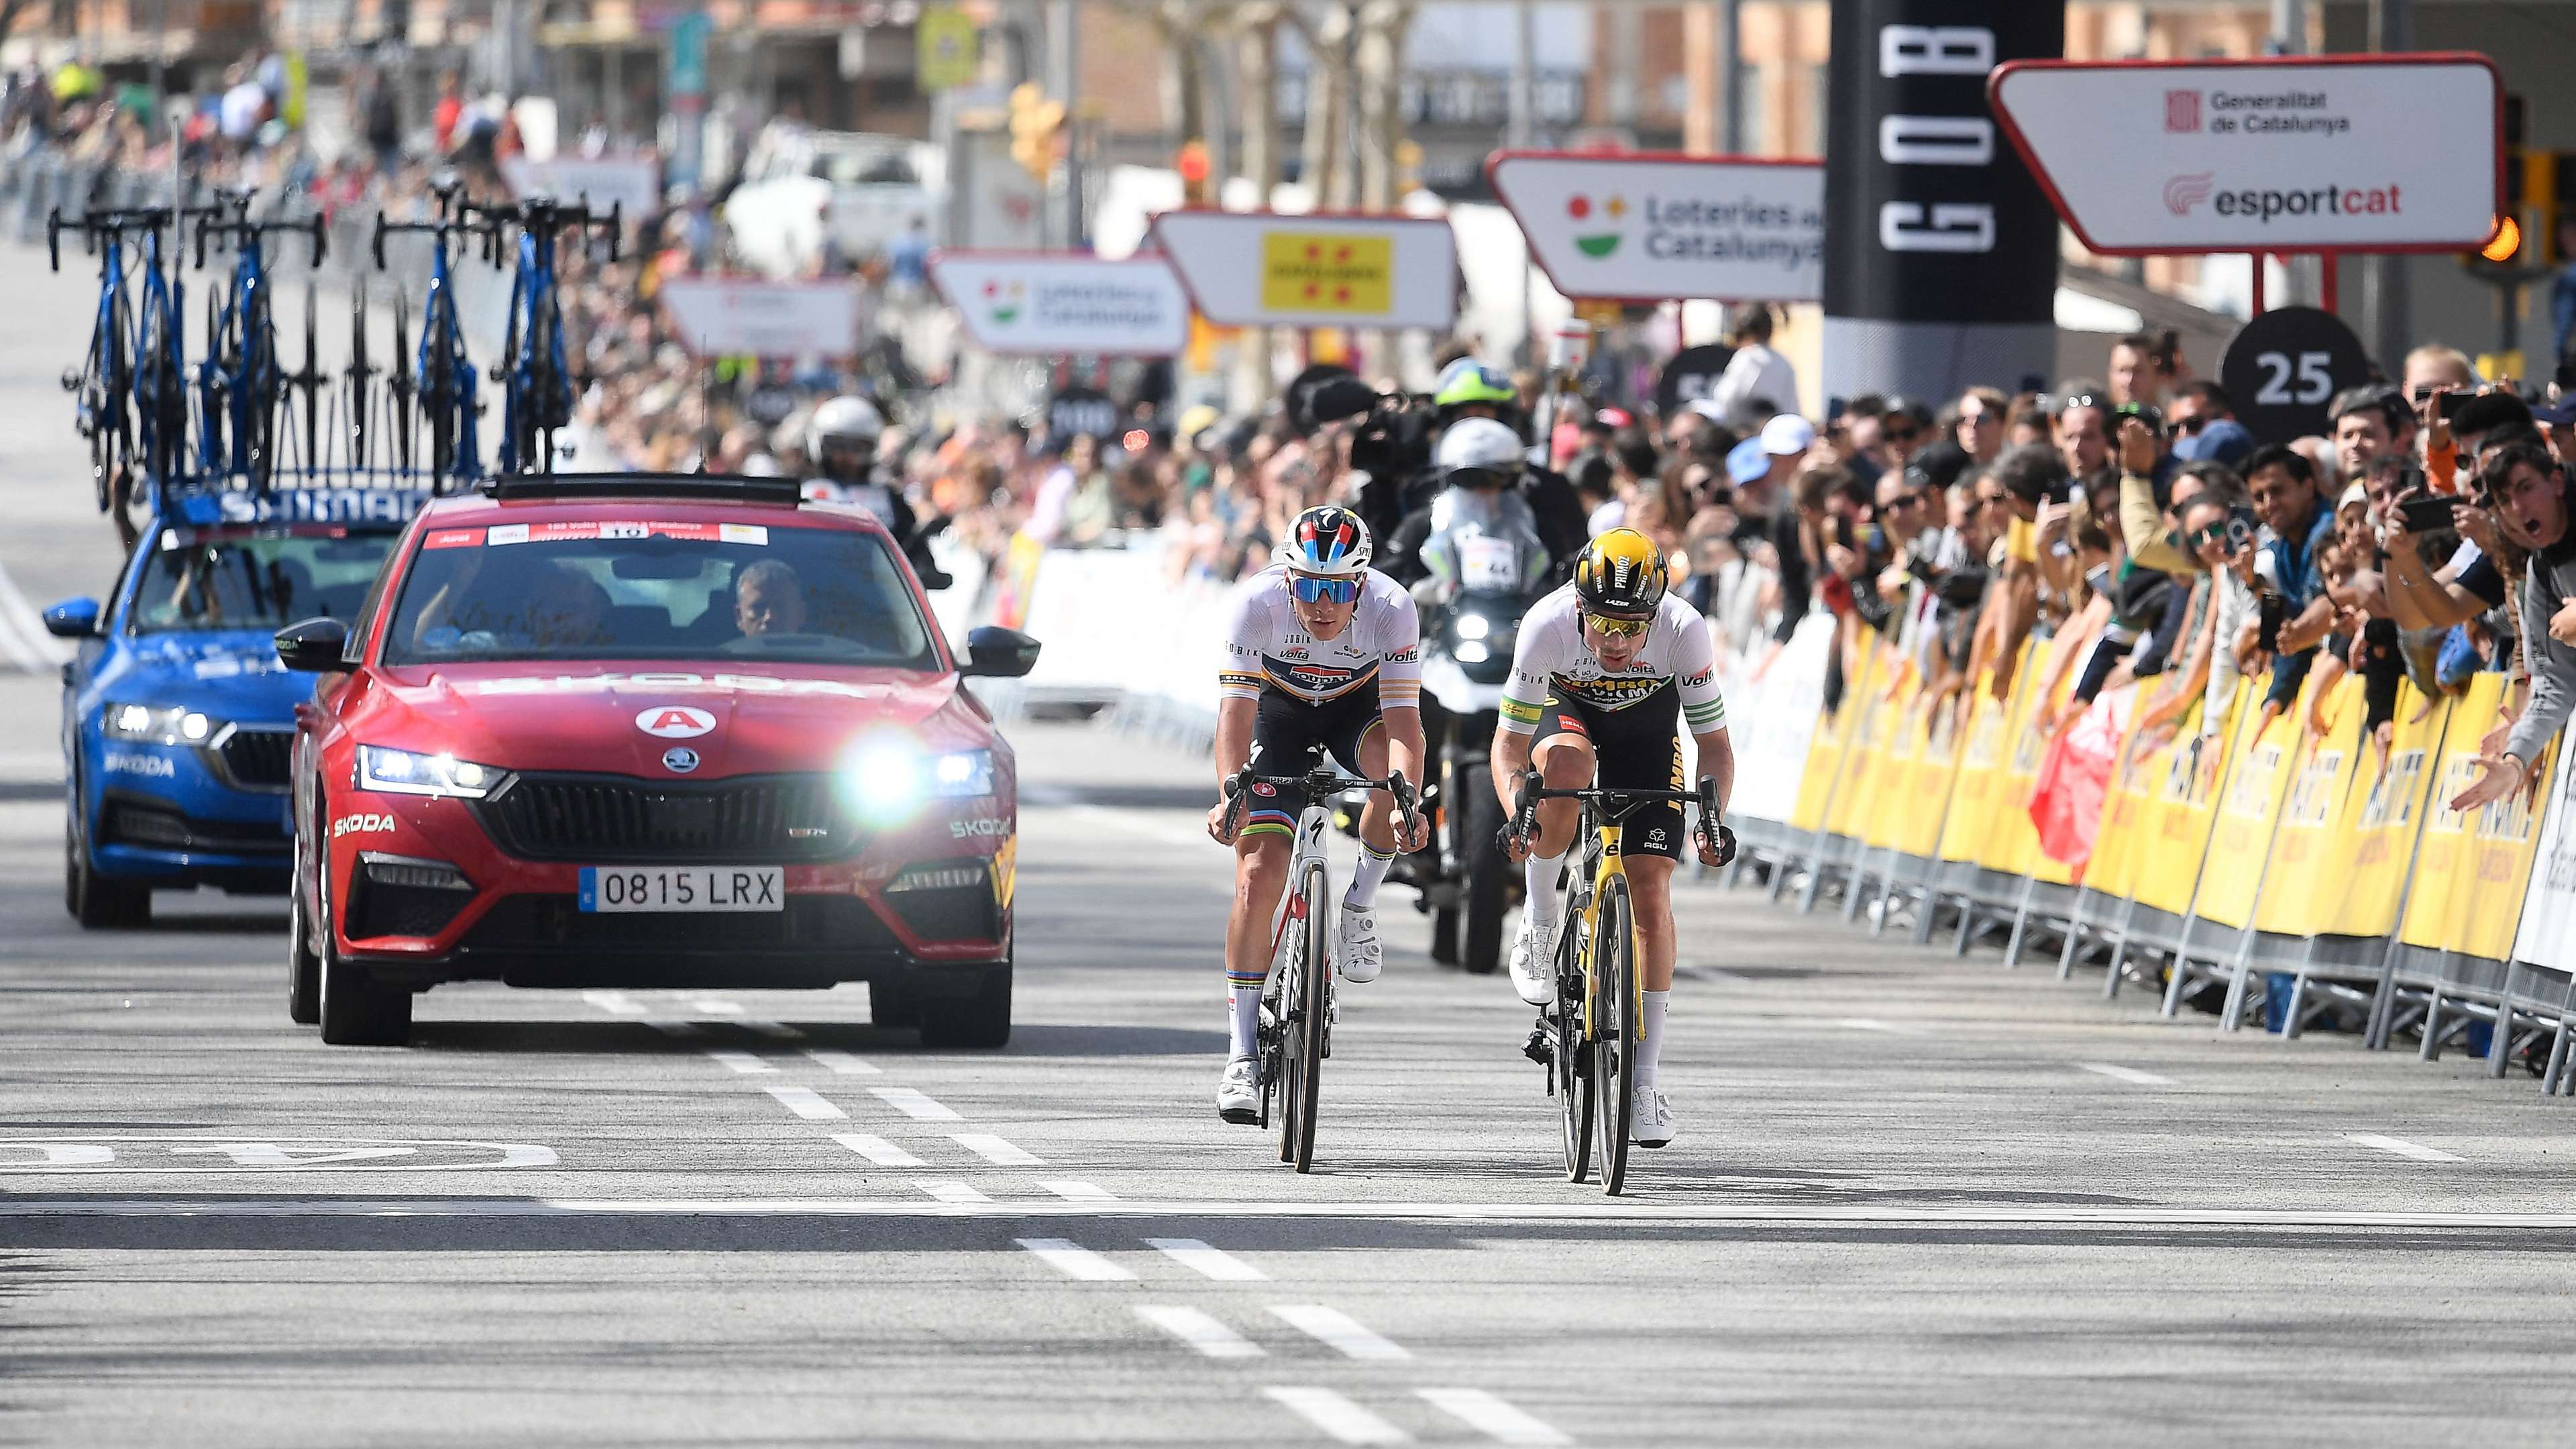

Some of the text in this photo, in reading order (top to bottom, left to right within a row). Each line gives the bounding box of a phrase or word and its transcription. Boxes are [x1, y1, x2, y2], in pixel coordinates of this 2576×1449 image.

[2211, 92, 2326, 110] Generalitat
[2211, 115, 2350, 137] de Catalunya
[1646, 195, 1790, 225] Loteries
[2216, 184, 2401, 223] esportcat
[2255, 351, 2333, 405] 25
[1614, 554, 1631, 589] PRIMOZ
[651, 711, 704, 729] A
[1520, 806, 1534, 845] SRAM
[1644, 842, 1668, 851] AGU
[606, 873, 774, 904] 0815 LRX
